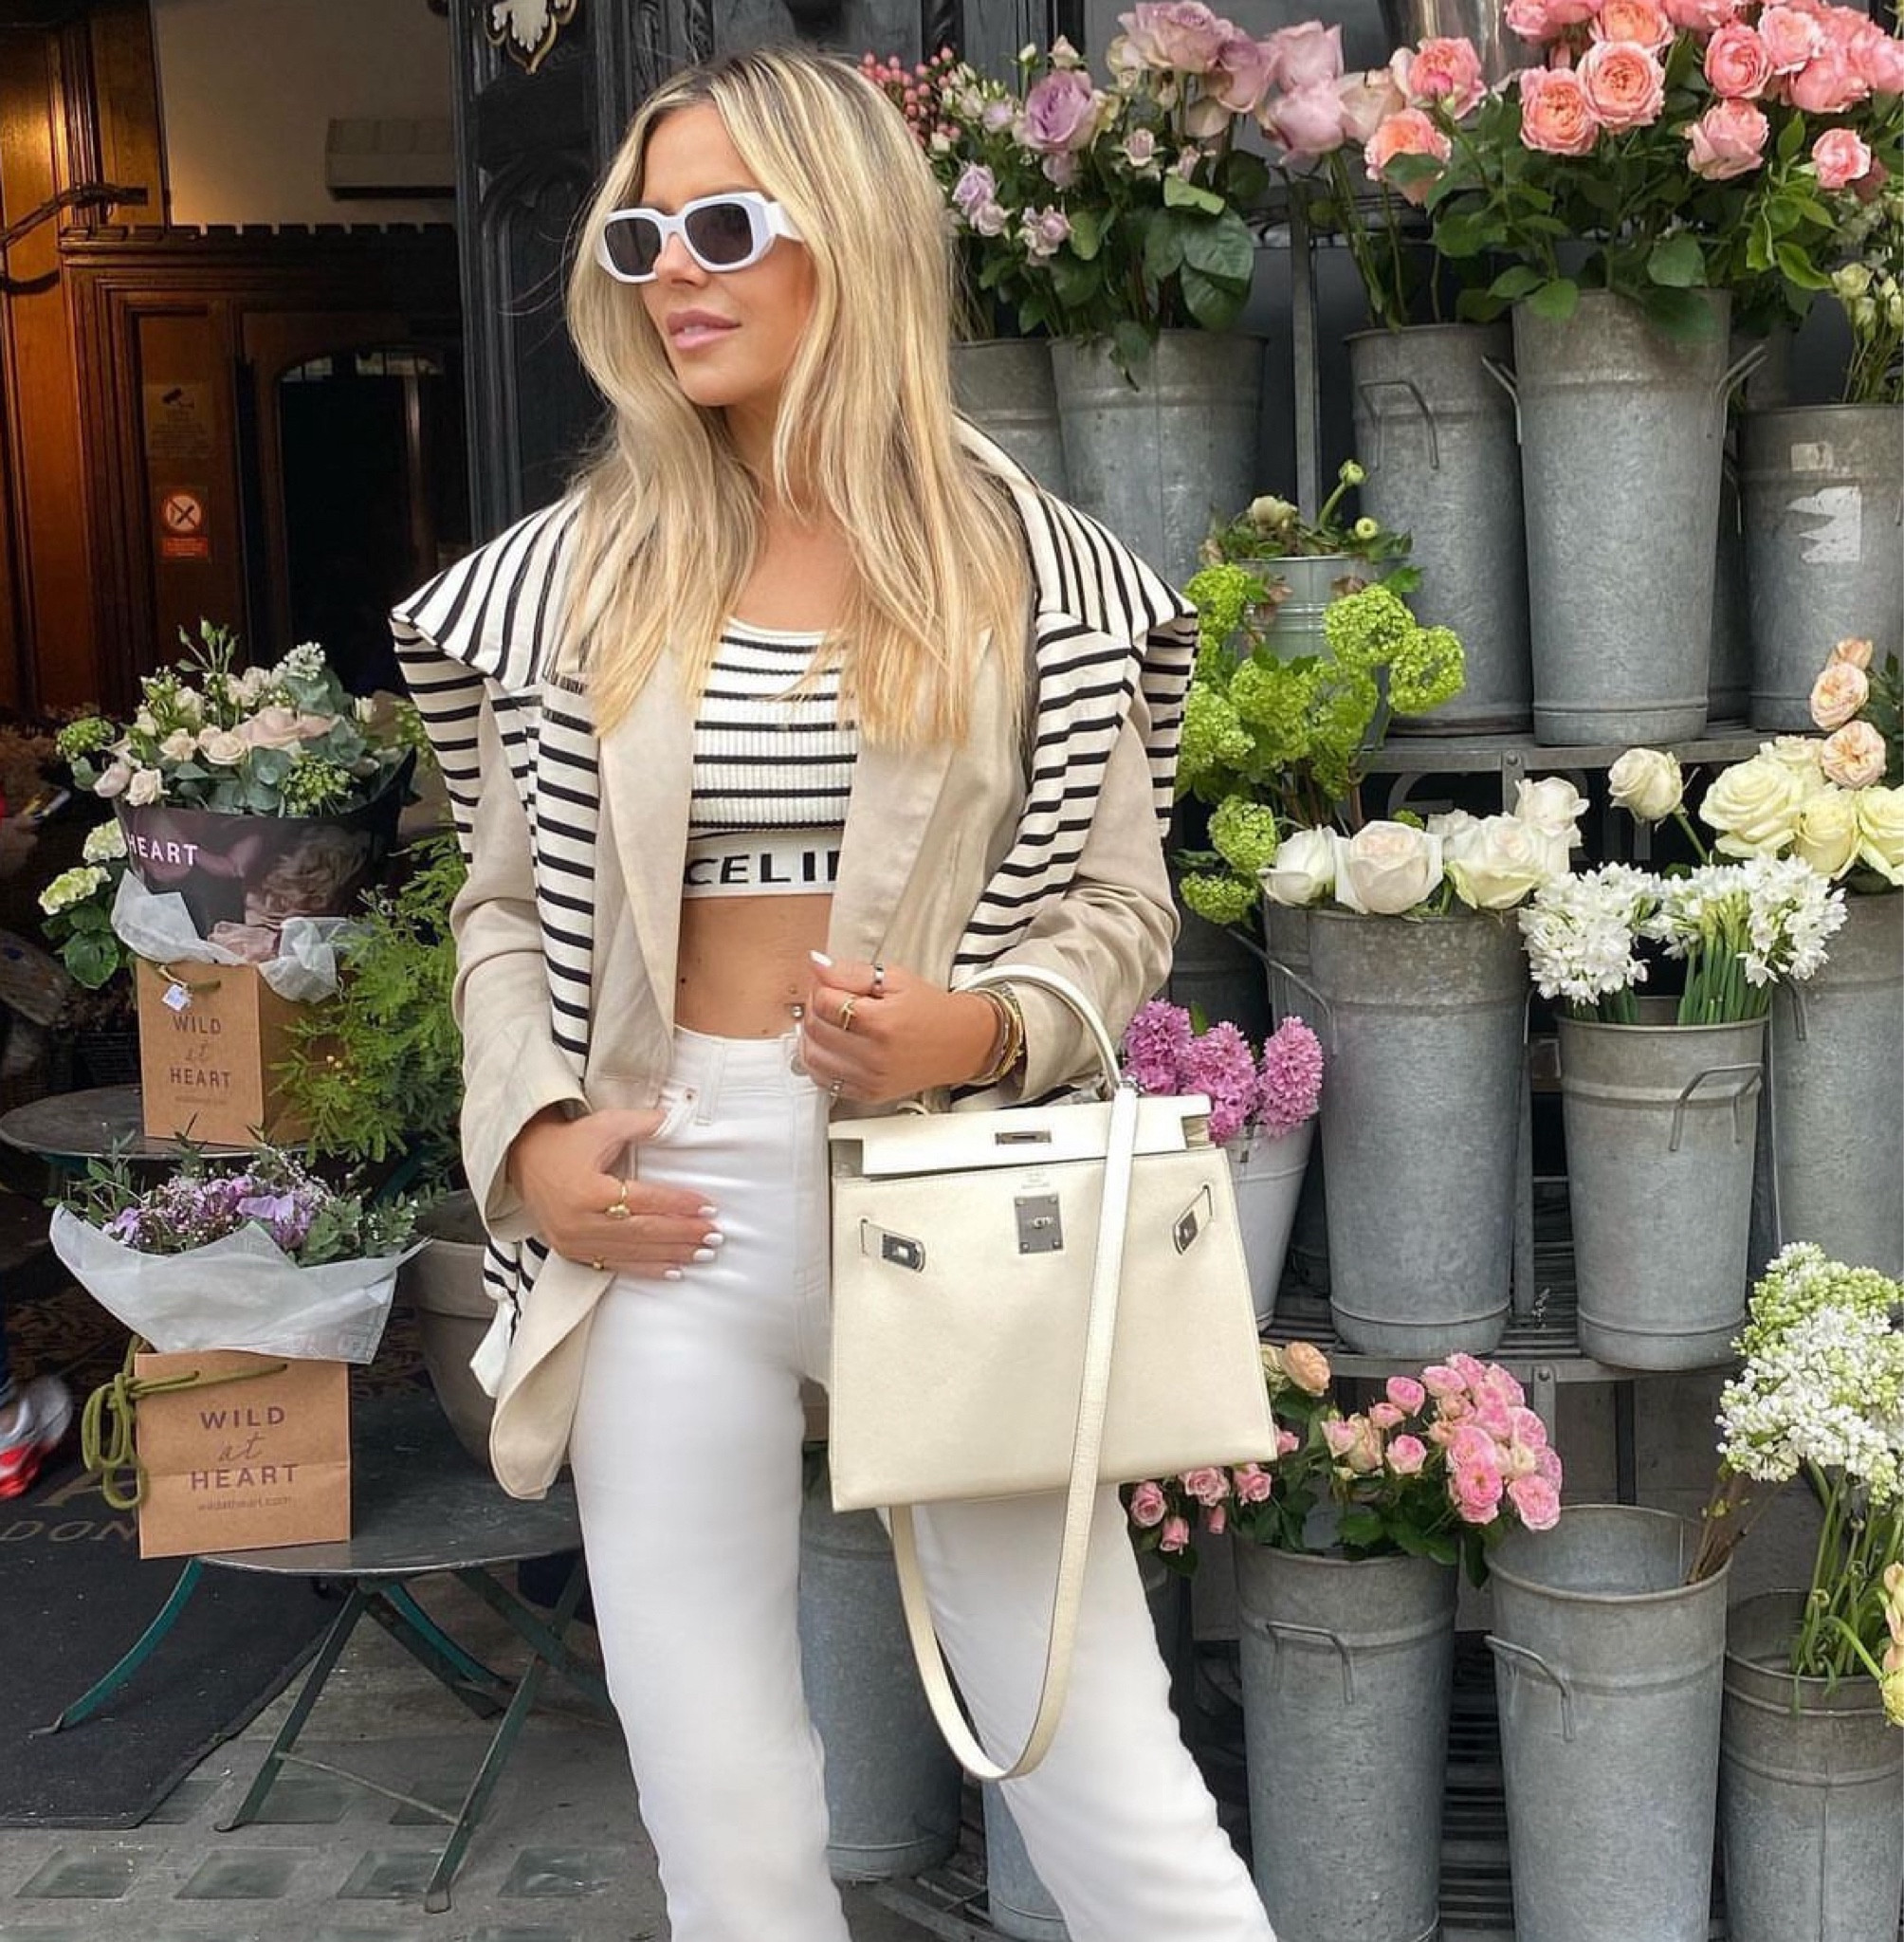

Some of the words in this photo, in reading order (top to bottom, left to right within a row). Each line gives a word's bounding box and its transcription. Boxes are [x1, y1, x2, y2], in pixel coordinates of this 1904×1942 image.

[126, 833, 198, 867] HEART
[173, 1015, 222, 1035] WILD
[170, 1067, 231, 1090] HEART
[199, 1406, 285, 1430] WILD
[218, 1430, 266, 1462] at
[191, 1463, 301, 1492] HEART
